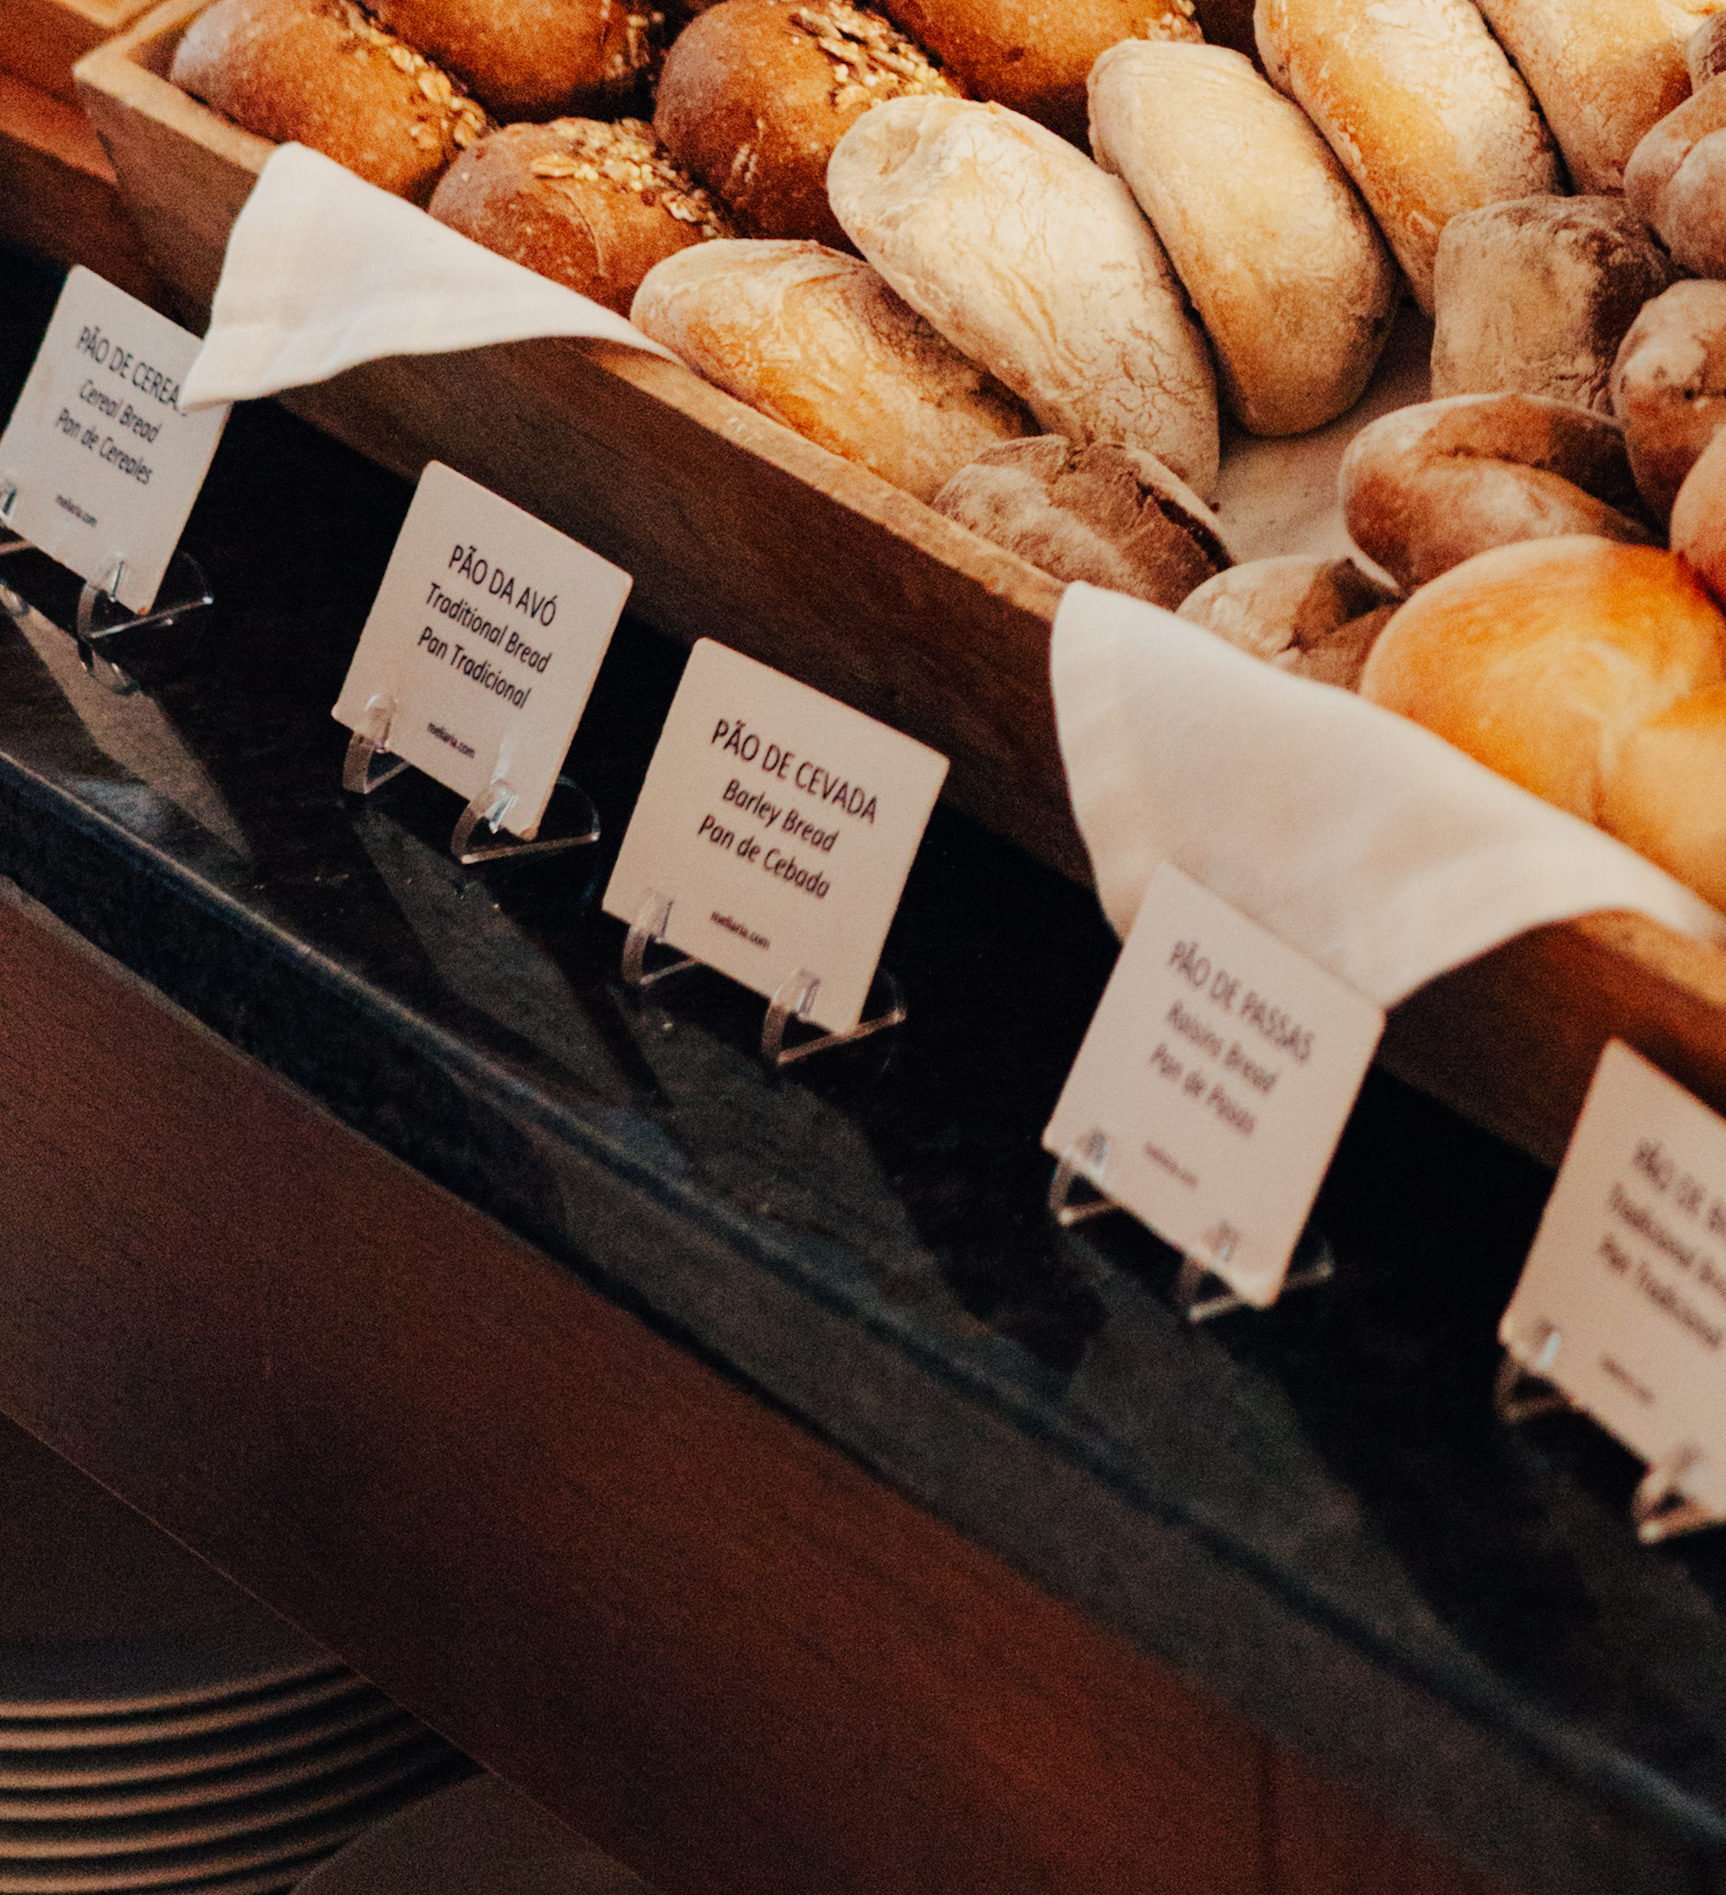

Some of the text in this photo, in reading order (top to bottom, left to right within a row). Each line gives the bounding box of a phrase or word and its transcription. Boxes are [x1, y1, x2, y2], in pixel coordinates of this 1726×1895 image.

[76, 325, 188, 418] PÃO DE CEREA
[78, 378, 162, 444] Cereal Bread
[55, 407, 154, 486] Pan de Cereales
[425, 581, 553, 674] Traditional Bread
[447, 543, 558, 628] PÃO DA AVÓ
[416, 625, 532, 709] Pan Tradicional
[710, 718, 878, 825] PÃO DE CEVADA
[697, 813, 831, 900] Pan de Cebada
[721, 778, 840, 854] Barley Bread
[1168, 940, 1315, 1065] PÃO DE PASSAS
[1149, 1042, 1184, 1083] Pan
[1182, 1071, 1207, 1099] de
[1165, 1000, 1279, 1096] Raisins Bread
